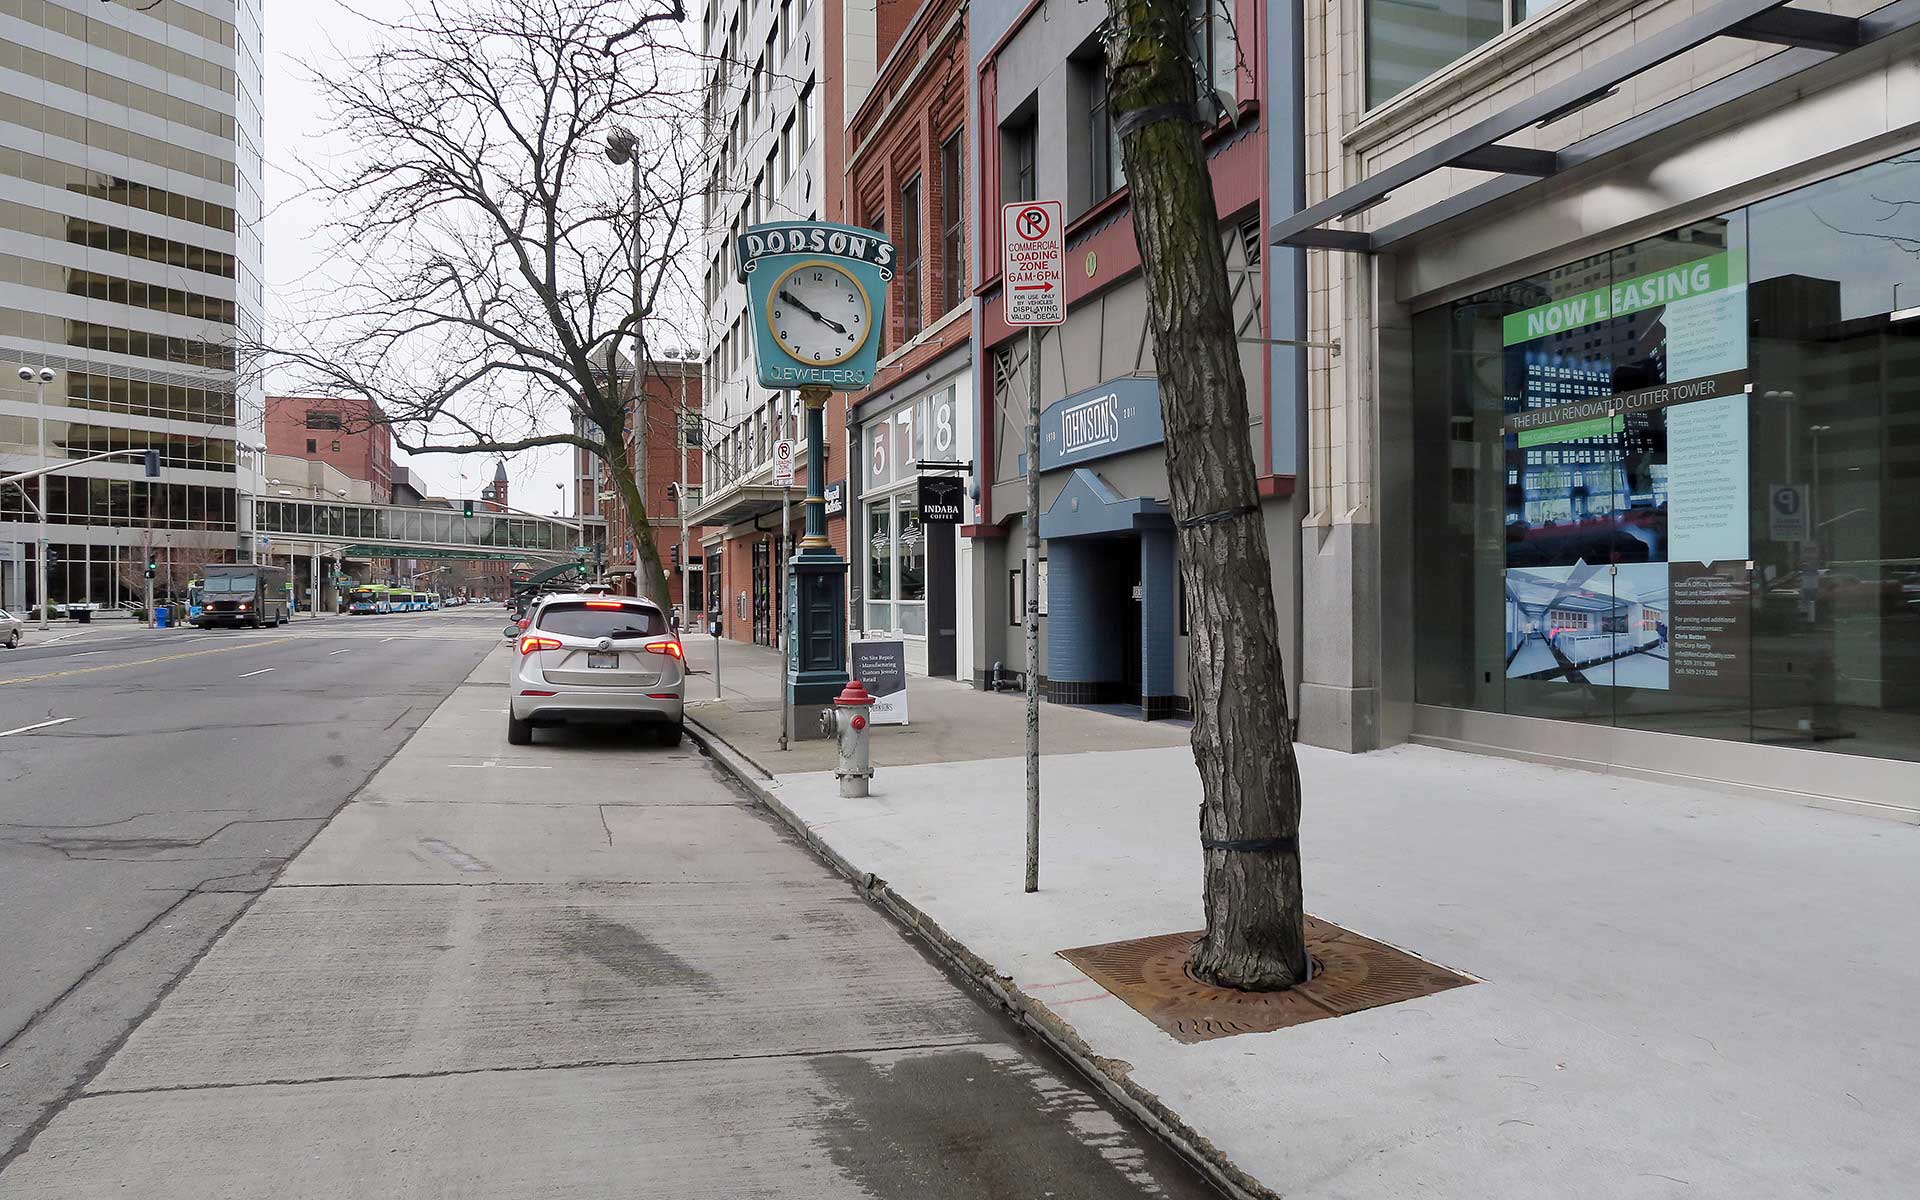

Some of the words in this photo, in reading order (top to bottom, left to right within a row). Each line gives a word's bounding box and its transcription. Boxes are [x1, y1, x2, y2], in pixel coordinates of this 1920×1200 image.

[747, 229, 894, 264] DODSON'S
[1009, 241, 1059, 252] COMMERCIAL
[1010, 251, 1058, 261] LOADING
[1020, 261, 1048, 271] ZONE
[793, 277, 801, 286] 11
[813, 272, 823, 282] 12
[1008, 271, 1059, 282] 6AM-6PM
[847, 294, 854, 303] 2
[1527, 300, 1587, 337] NOW
[1594, 263, 1710, 320] LEASING
[774, 310, 782, 319] 9
[1013, 305, 1058, 314] DISPLAYING
[853, 314, 860, 323] 3
[1037, 312, 1060, 320] DECAL
[780, 330, 788, 340] 8
[847, 333, 855, 343] 4
[794, 345, 801, 354] 7
[834, 347, 842, 357] 5
[813, 351, 821, 361] 6
[771, 365, 866, 383] JEWELERS
[1513, 415, 1531, 429] THE
[1532, 408, 1561, 426] FULLY
[1626, 388, 1669, 409] CUTTER
[1671, 380, 1716, 400] TOWER
[1060, 393, 1119, 457] JOHNSONS
[924, 505, 959, 514] INDABA
